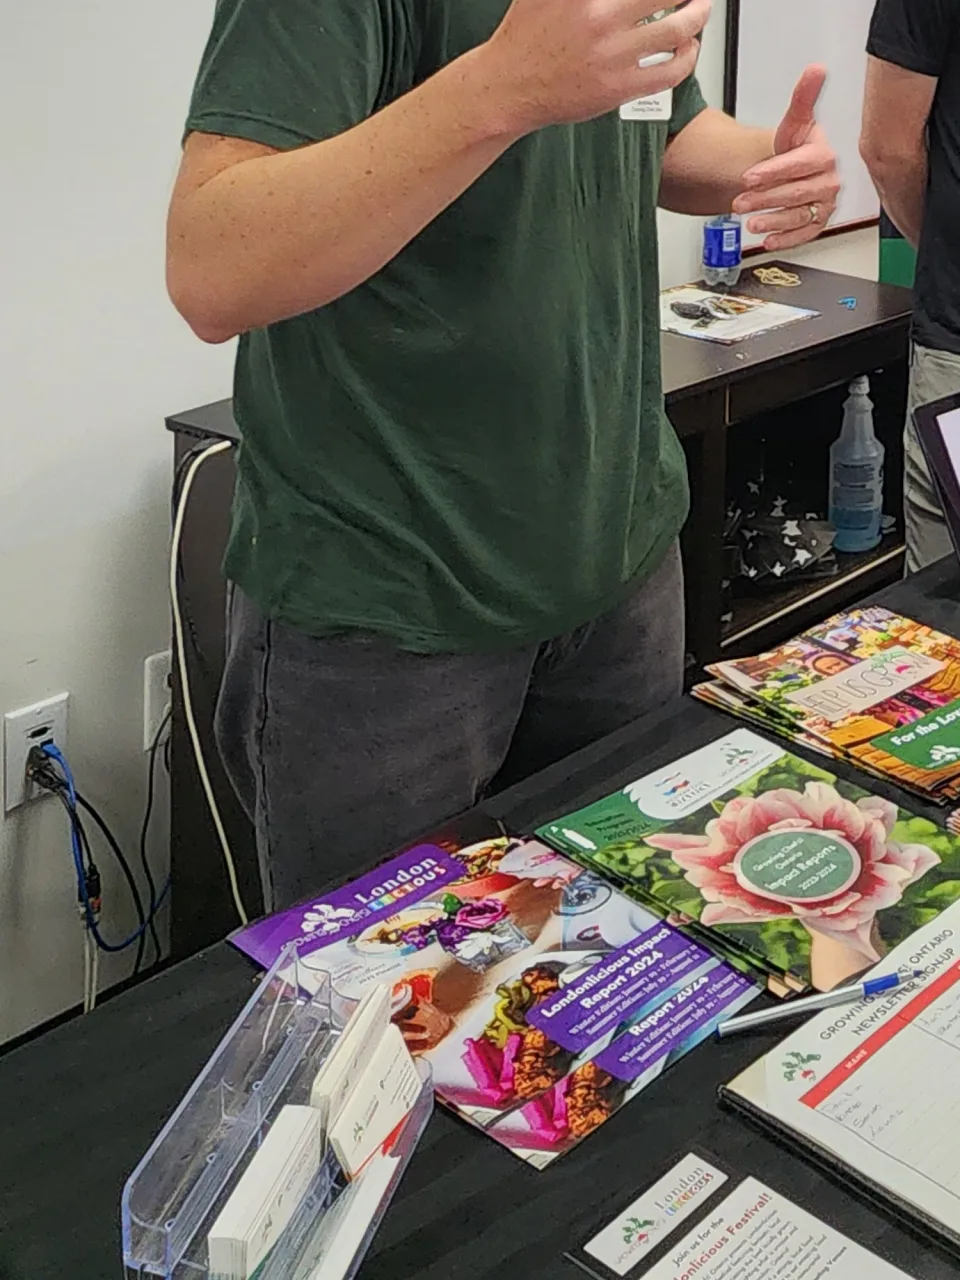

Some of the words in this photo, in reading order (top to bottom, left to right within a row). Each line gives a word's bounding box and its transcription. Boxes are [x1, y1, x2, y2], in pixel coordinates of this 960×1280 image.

[890, 730, 916, 746] For
[916, 720, 939, 735] the
[354, 857, 438, 904] London
[753, 851, 784, 872] Growing
[764, 868, 800, 890] Impact
[796, 844, 836, 871] Reports
[775, 851, 802, 869] Ontario
[541, 956, 631, 1017] Londonlicious
[628, 928, 672, 957] Impact
[580, 976, 628, 1008] Report
[625, 950, 664, 977] 2024
[820, 994, 875, 1040] GROWING
[909, 929, 953, 964] ONTARIO
[852, 981, 918, 1036] NEWSLETTER
[920, 948, 955, 982] SIGN-UP
[628, 1003, 675, 1036] Report
[845, 1048, 868, 1070] NAME
[655, 1167, 704, 1209] London
[672, 1250, 690, 1268] Join
[690, 1241, 700, 1250] us
[697, 1229, 711, 1241] for
[710, 1218, 724, 1229] the
[675, 1236, 729, 1280] onlicious
[726, 1193, 772, 1236] Festival!
